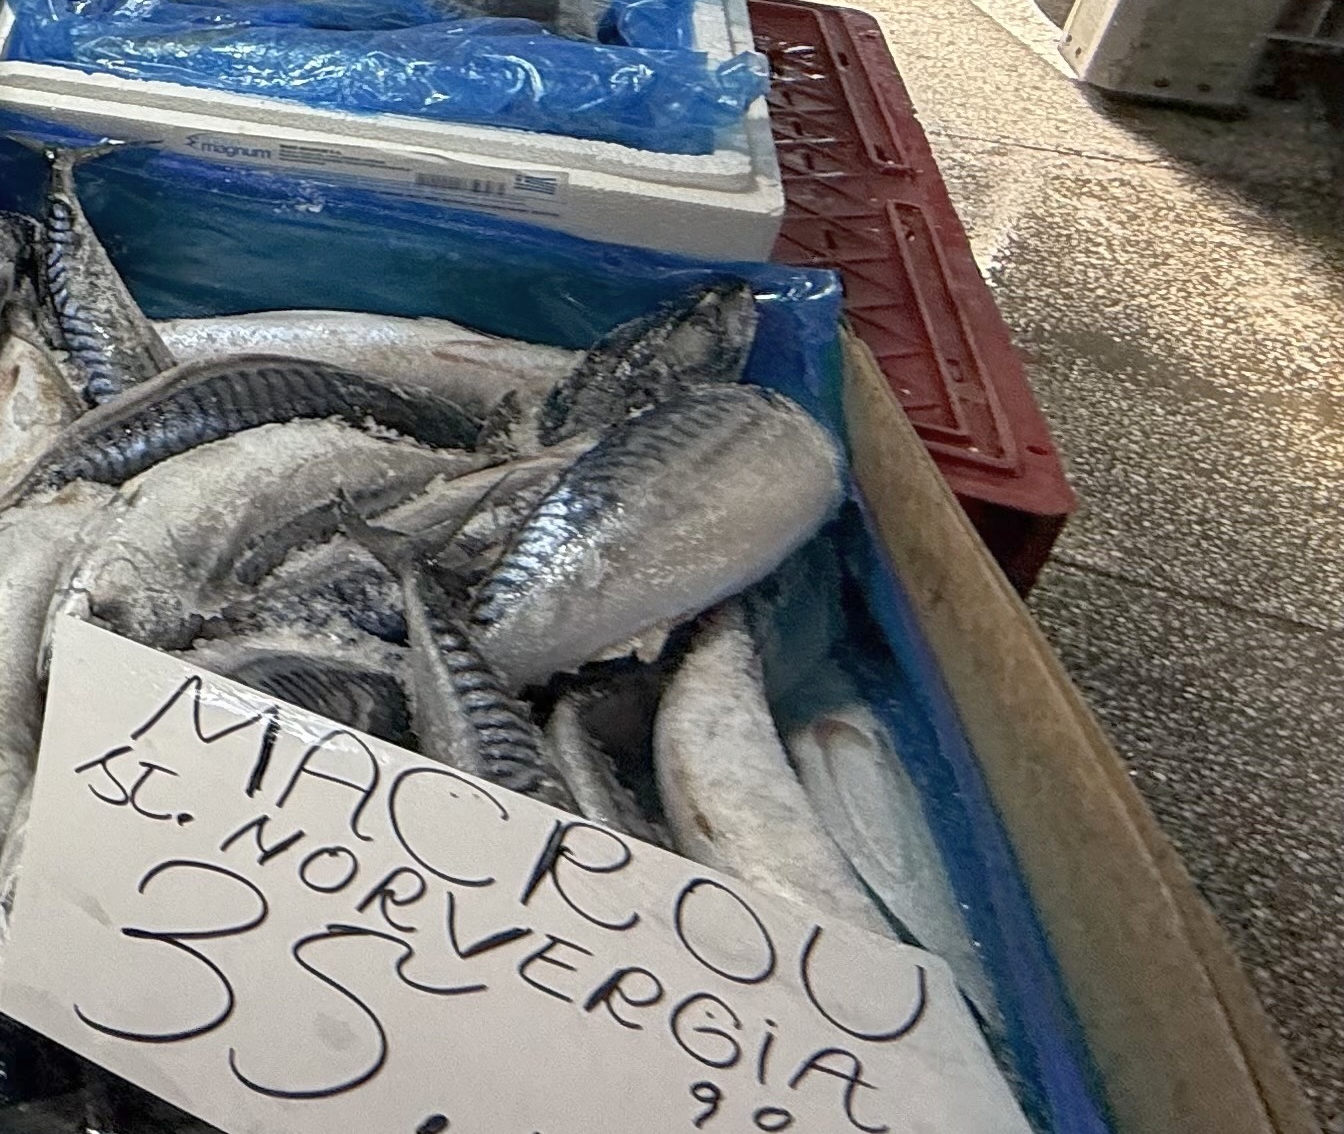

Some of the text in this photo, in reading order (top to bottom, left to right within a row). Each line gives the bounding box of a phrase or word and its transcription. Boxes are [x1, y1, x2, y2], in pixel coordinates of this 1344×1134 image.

[73, 858, 795, 1132] 35 90
[129, 674, 929, 1044] MACROU
